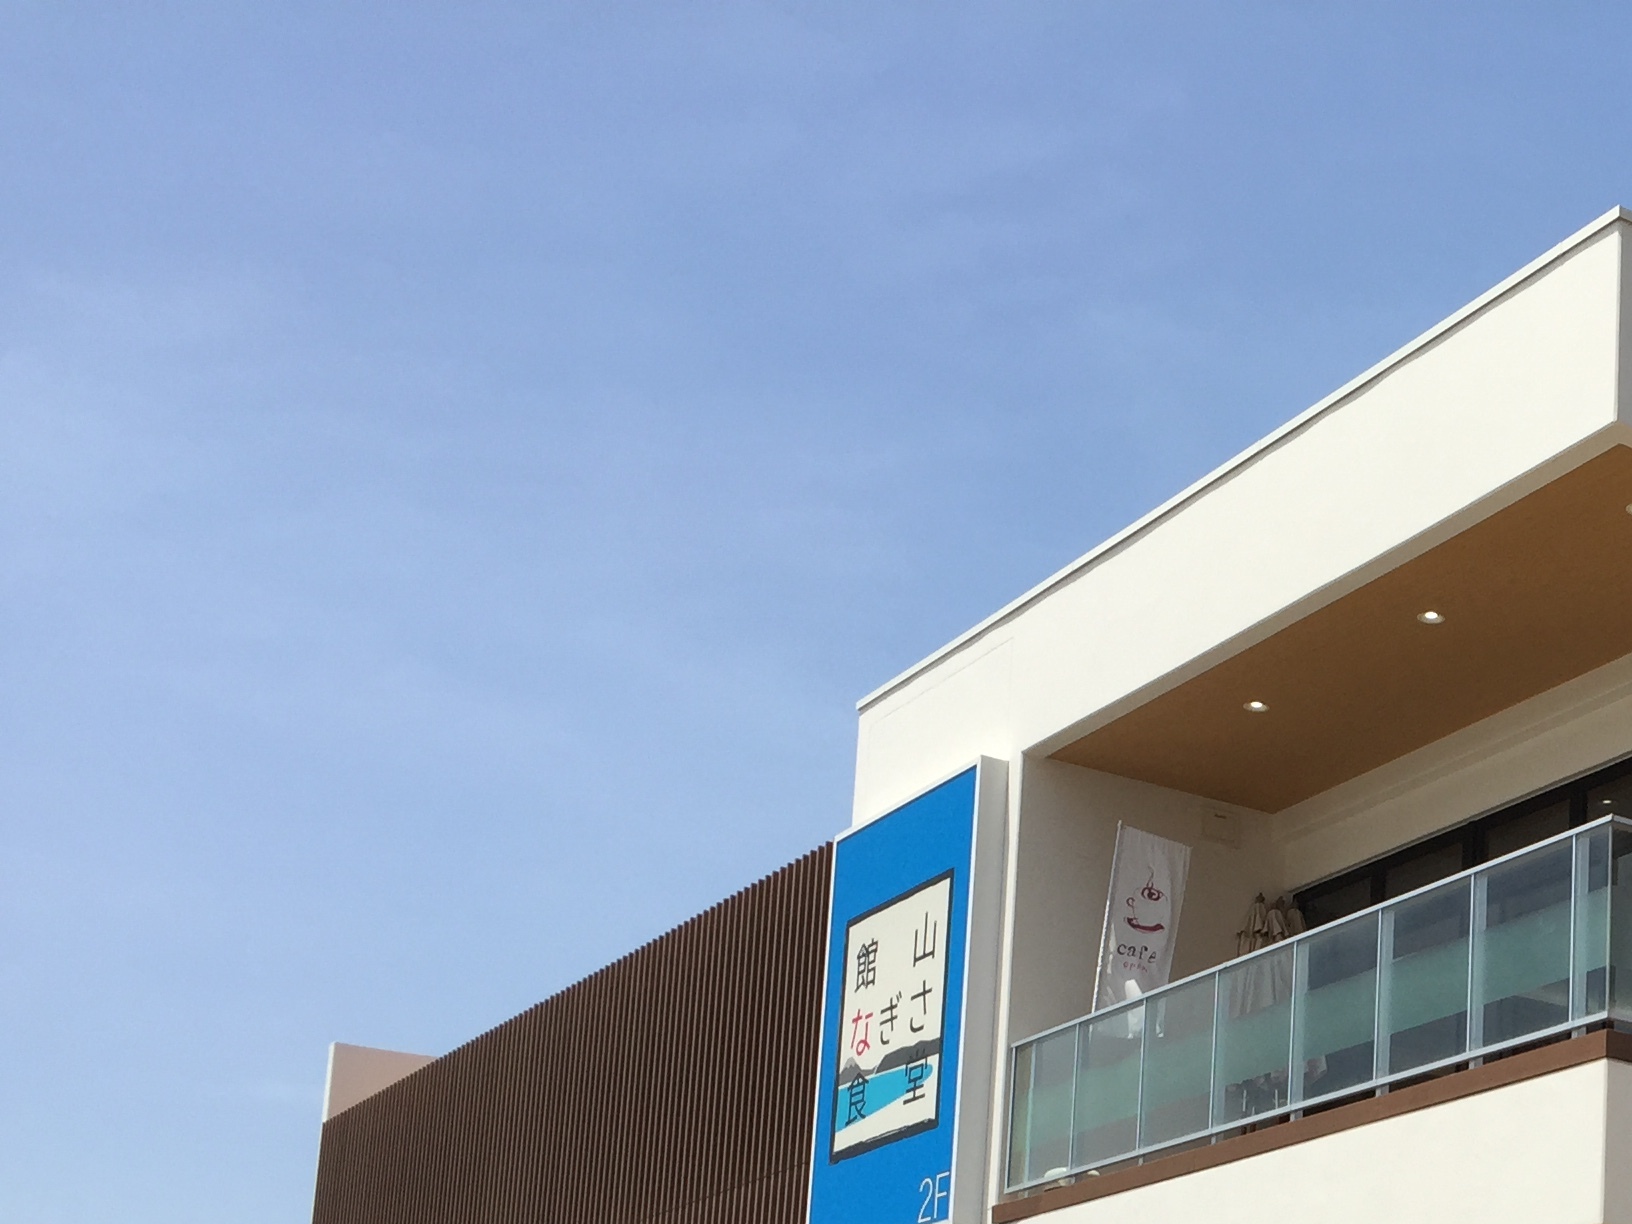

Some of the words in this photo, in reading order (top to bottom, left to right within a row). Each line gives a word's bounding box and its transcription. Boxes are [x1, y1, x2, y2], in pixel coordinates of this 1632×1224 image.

[1117, 943, 1157, 964] cafe
[850, 979, 934, 1057] なぎさ
[917, 1171, 951, 1224] 2F
